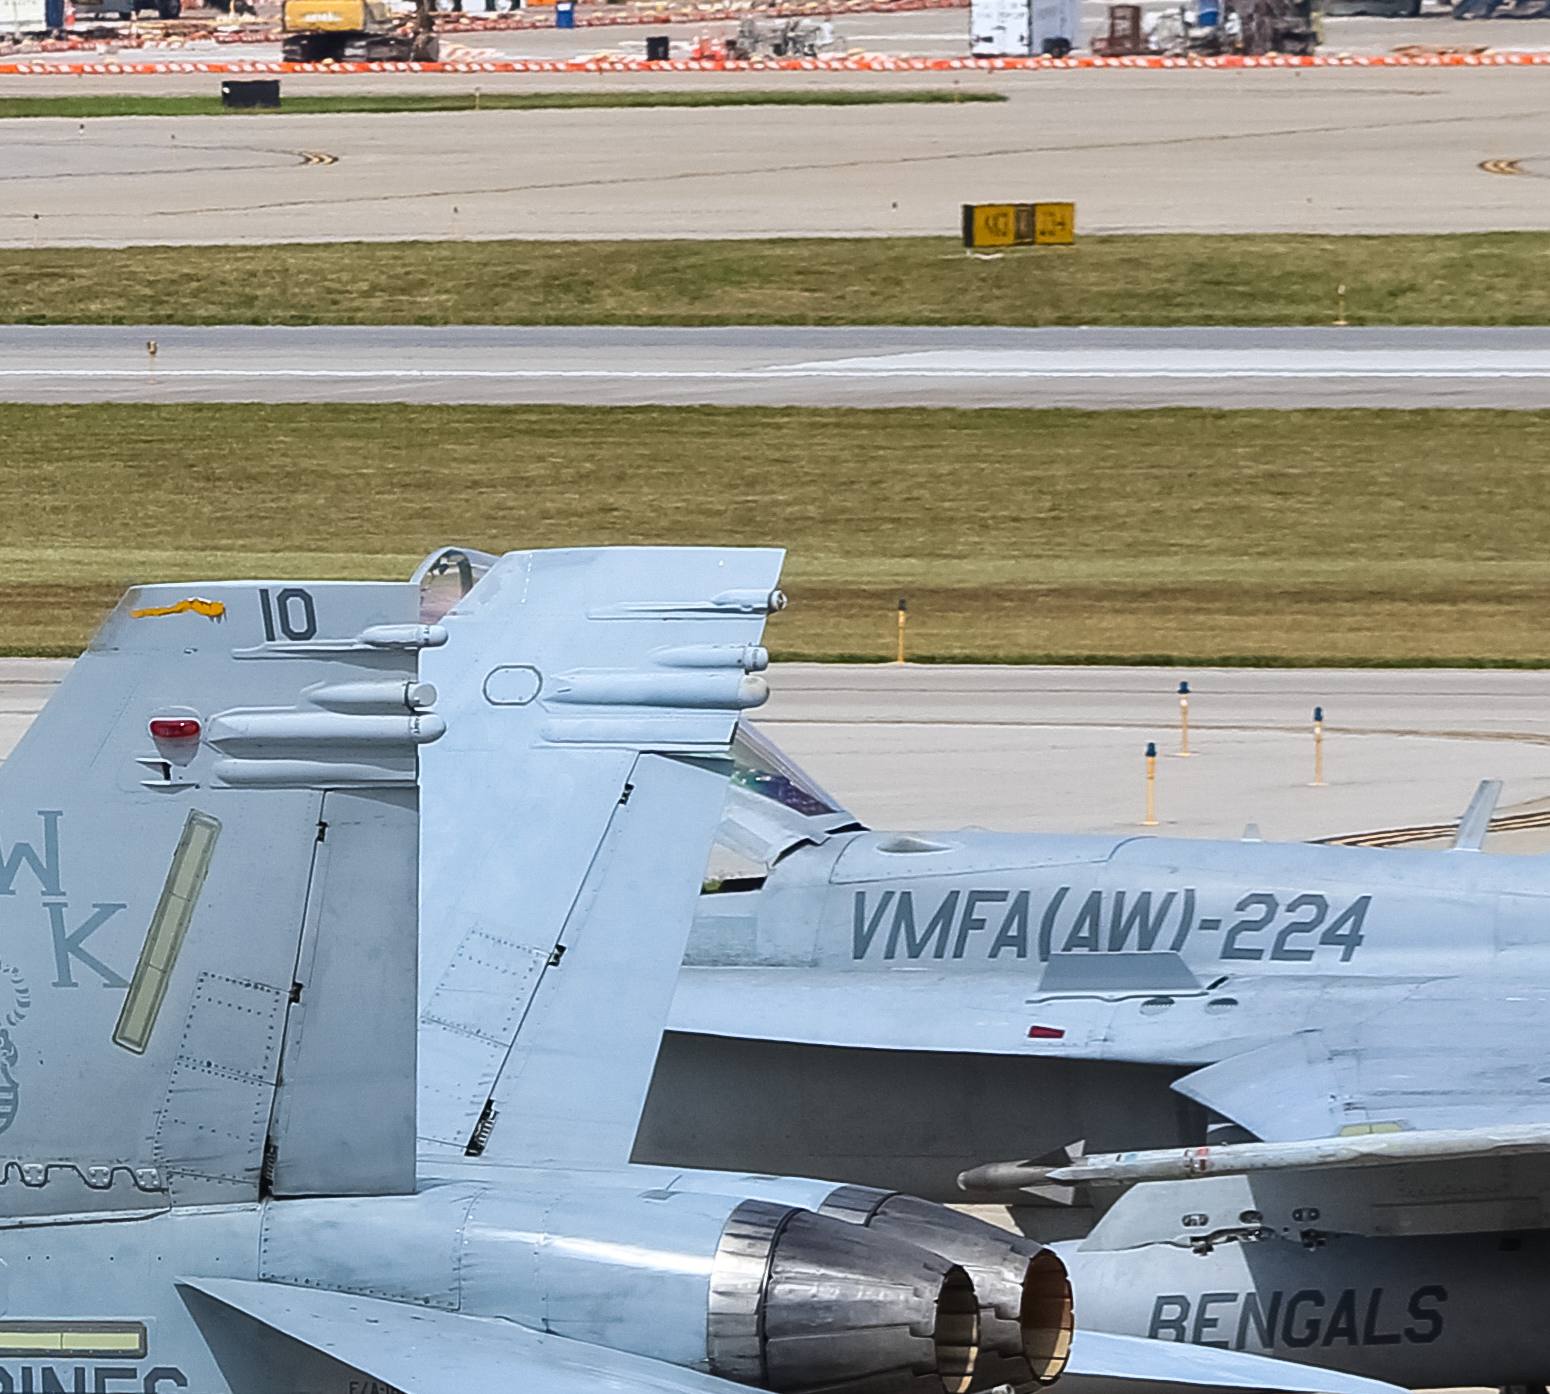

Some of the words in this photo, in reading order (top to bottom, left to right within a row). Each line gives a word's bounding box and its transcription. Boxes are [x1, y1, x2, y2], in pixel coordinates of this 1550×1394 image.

[257, 586, 319, 642] 10
[42, 901, 129, 988] K
[852, 886, 1374, 963] VMFA(AW)-224
[1148, 1283, 1449, 1352] BENGALS
